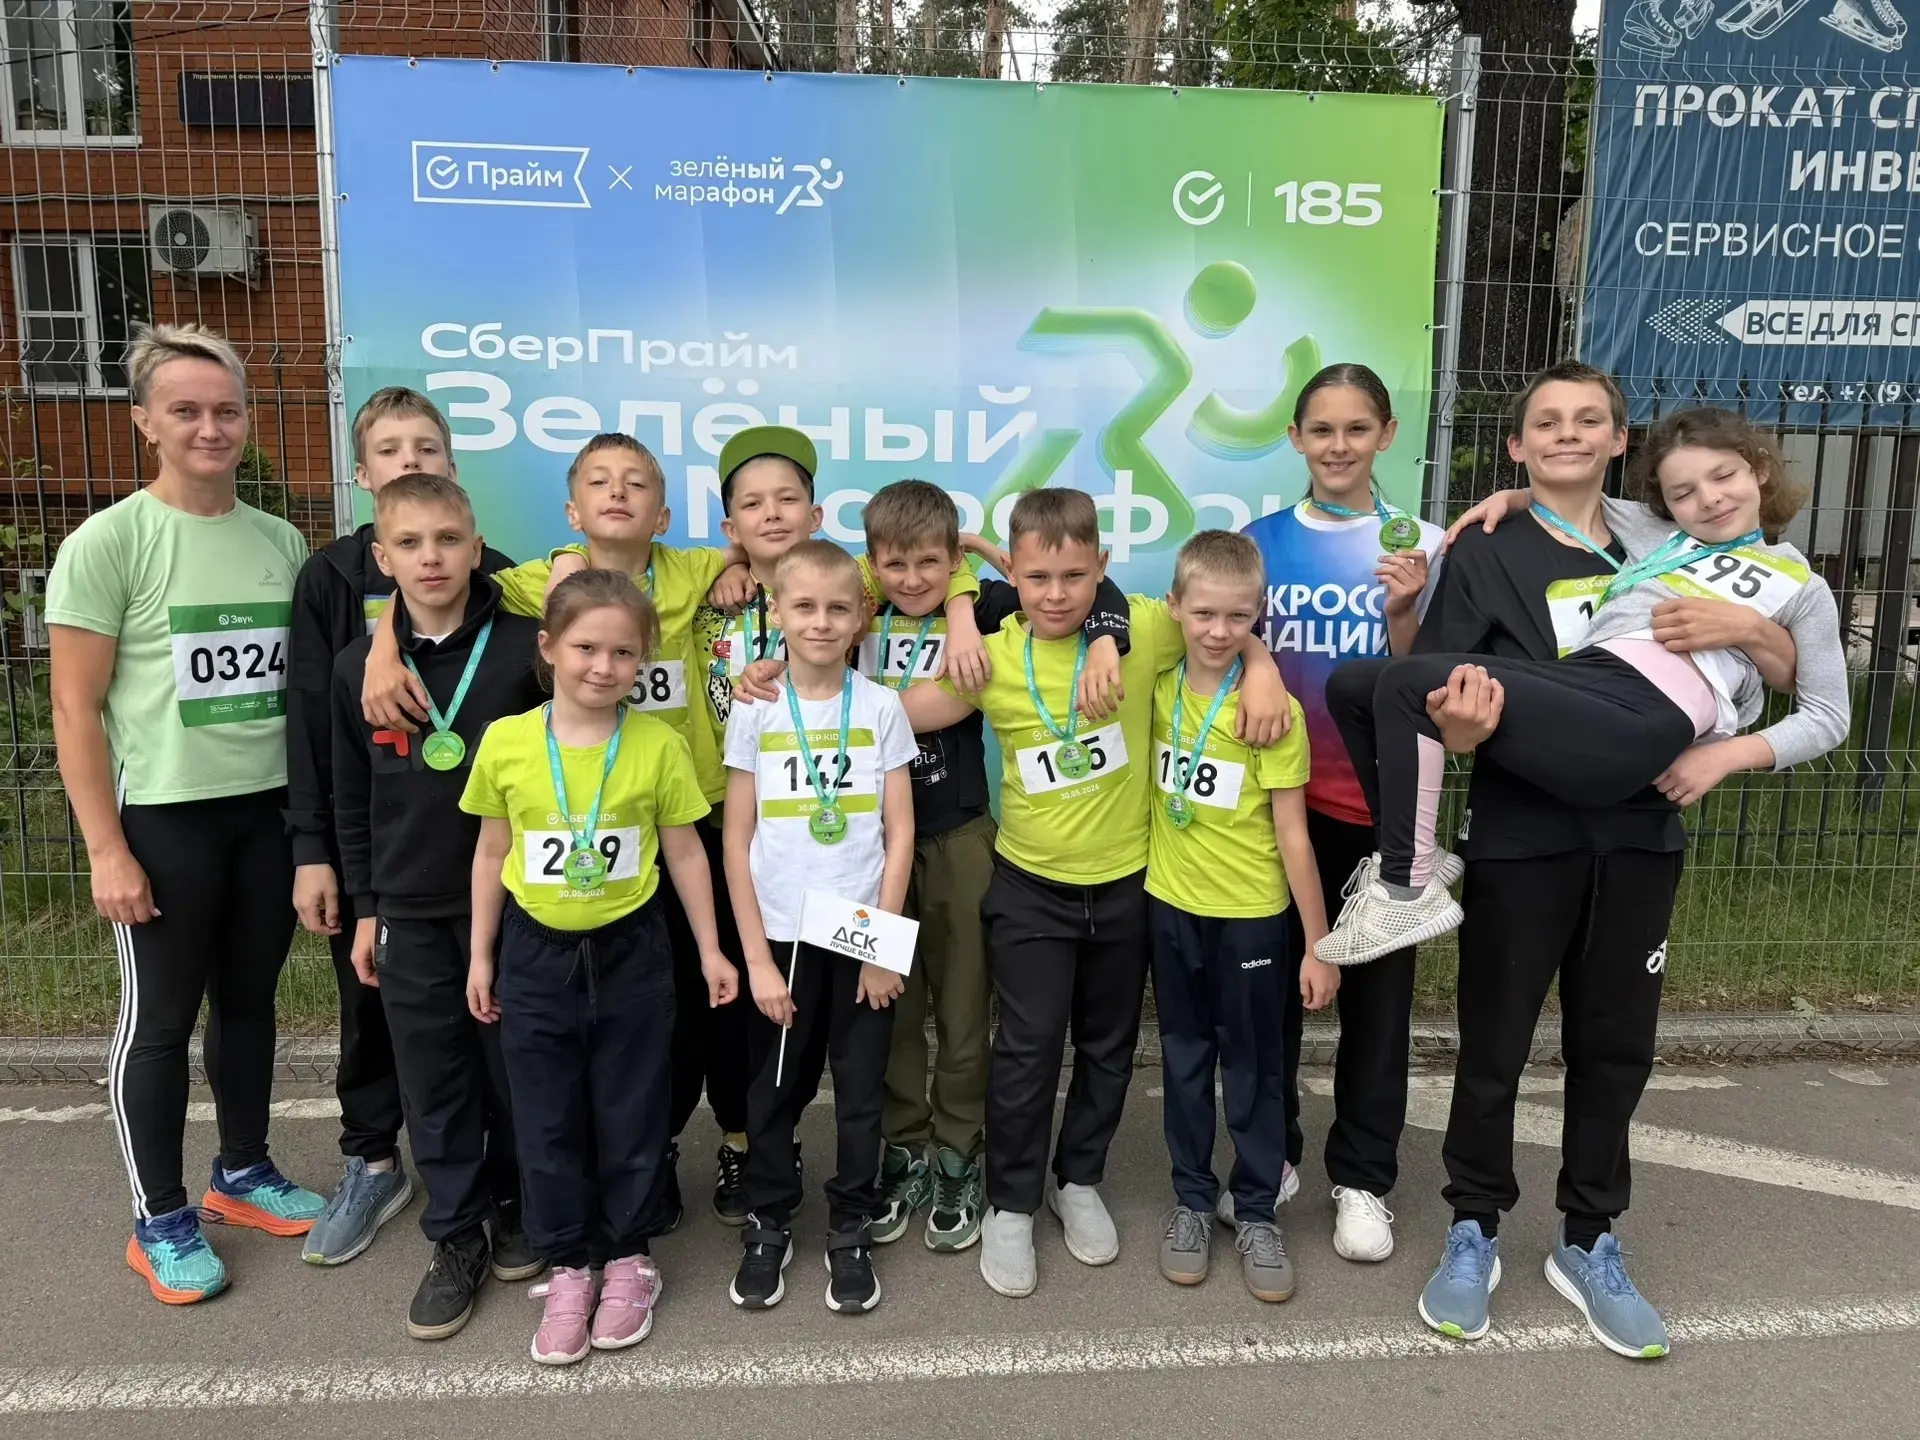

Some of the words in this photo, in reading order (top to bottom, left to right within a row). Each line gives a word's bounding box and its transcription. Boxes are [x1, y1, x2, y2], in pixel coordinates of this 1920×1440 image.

[1633, 84, 1855, 129] ПРОКАТ
[466, 160, 564, 190] Прайм
[669, 156, 785, 180] зелёный
[654, 180, 775, 208] марафон
[1274, 180, 1383, 226] 185
[1634, 221, 1905, 258] СЕРВИСНОЕ
[1746, 311, 1804, 336] ВСЕ
[1810, 312, 1882, 342] ДЛЯ
[420, 322, 798, 373] СберПрайм
[425, 370, 1038, 464] Зелёный
[1680, 543, 1773, 599] 95
[230, 614, 254, 624] Звук
[1266, 583, 1387, 619] КРОСС
[190, 641, 286, 684] 0324
[884, 638, 940, 671] 137
[783, 753, 853, 792] 142
[1036, 735, 1107, 783] 15
[1060, 784, 1101, 800] 30.05.2026
[542, 835, 621, 876] 29
[1241, 958, 1272, 969] adidas
